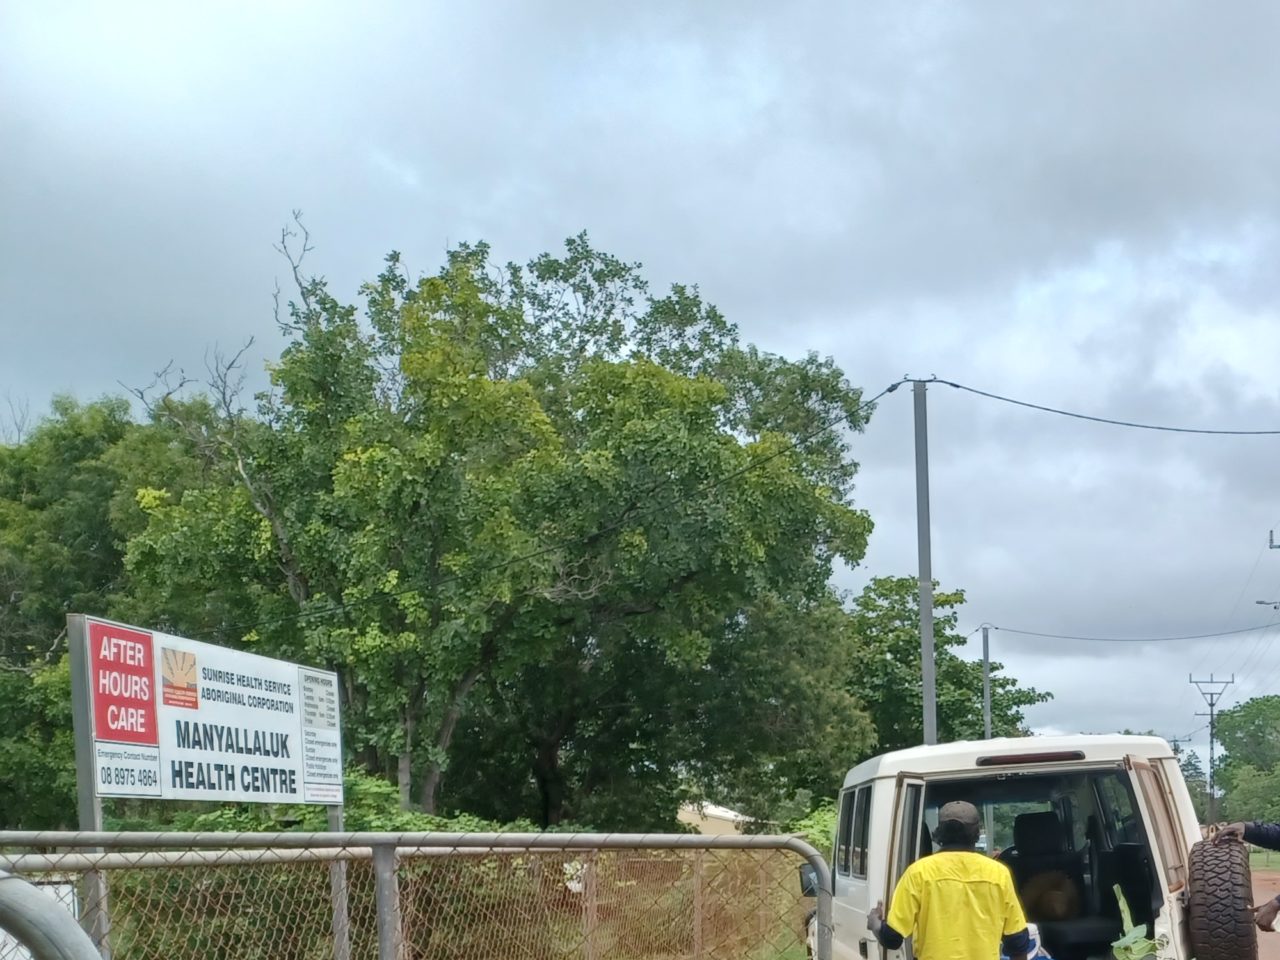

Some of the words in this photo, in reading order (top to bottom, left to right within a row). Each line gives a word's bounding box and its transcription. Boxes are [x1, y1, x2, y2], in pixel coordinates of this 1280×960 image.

[99, 636, 144, 667] AFTER
[99, 670, 149, 701] HOURS
[202, 667, 235, 685] SUNRISE
[236, 673, 263, 690] HEALTH
[264, 679, 291, 696] SERVICE
[201, 687, 246, 706] ABORIGINAL
[247, 695, 294, 714] CORPORATION
[108, 705, 146, 733] CARE
[175, 720, 290, 759] MANYALLALUK
[98, 749, 123, 761] Emergency
[124, 751, 141, 760] Contact
[141, 752, 158, 761] Number
[101, 766, 112, 785] 08
[115, 767, 135, 786] 8975
[138, 769, 157, 787] 4864
[171, 760, 236, 791] HEALTH
[240, 765, 297, 794] CENTRE
